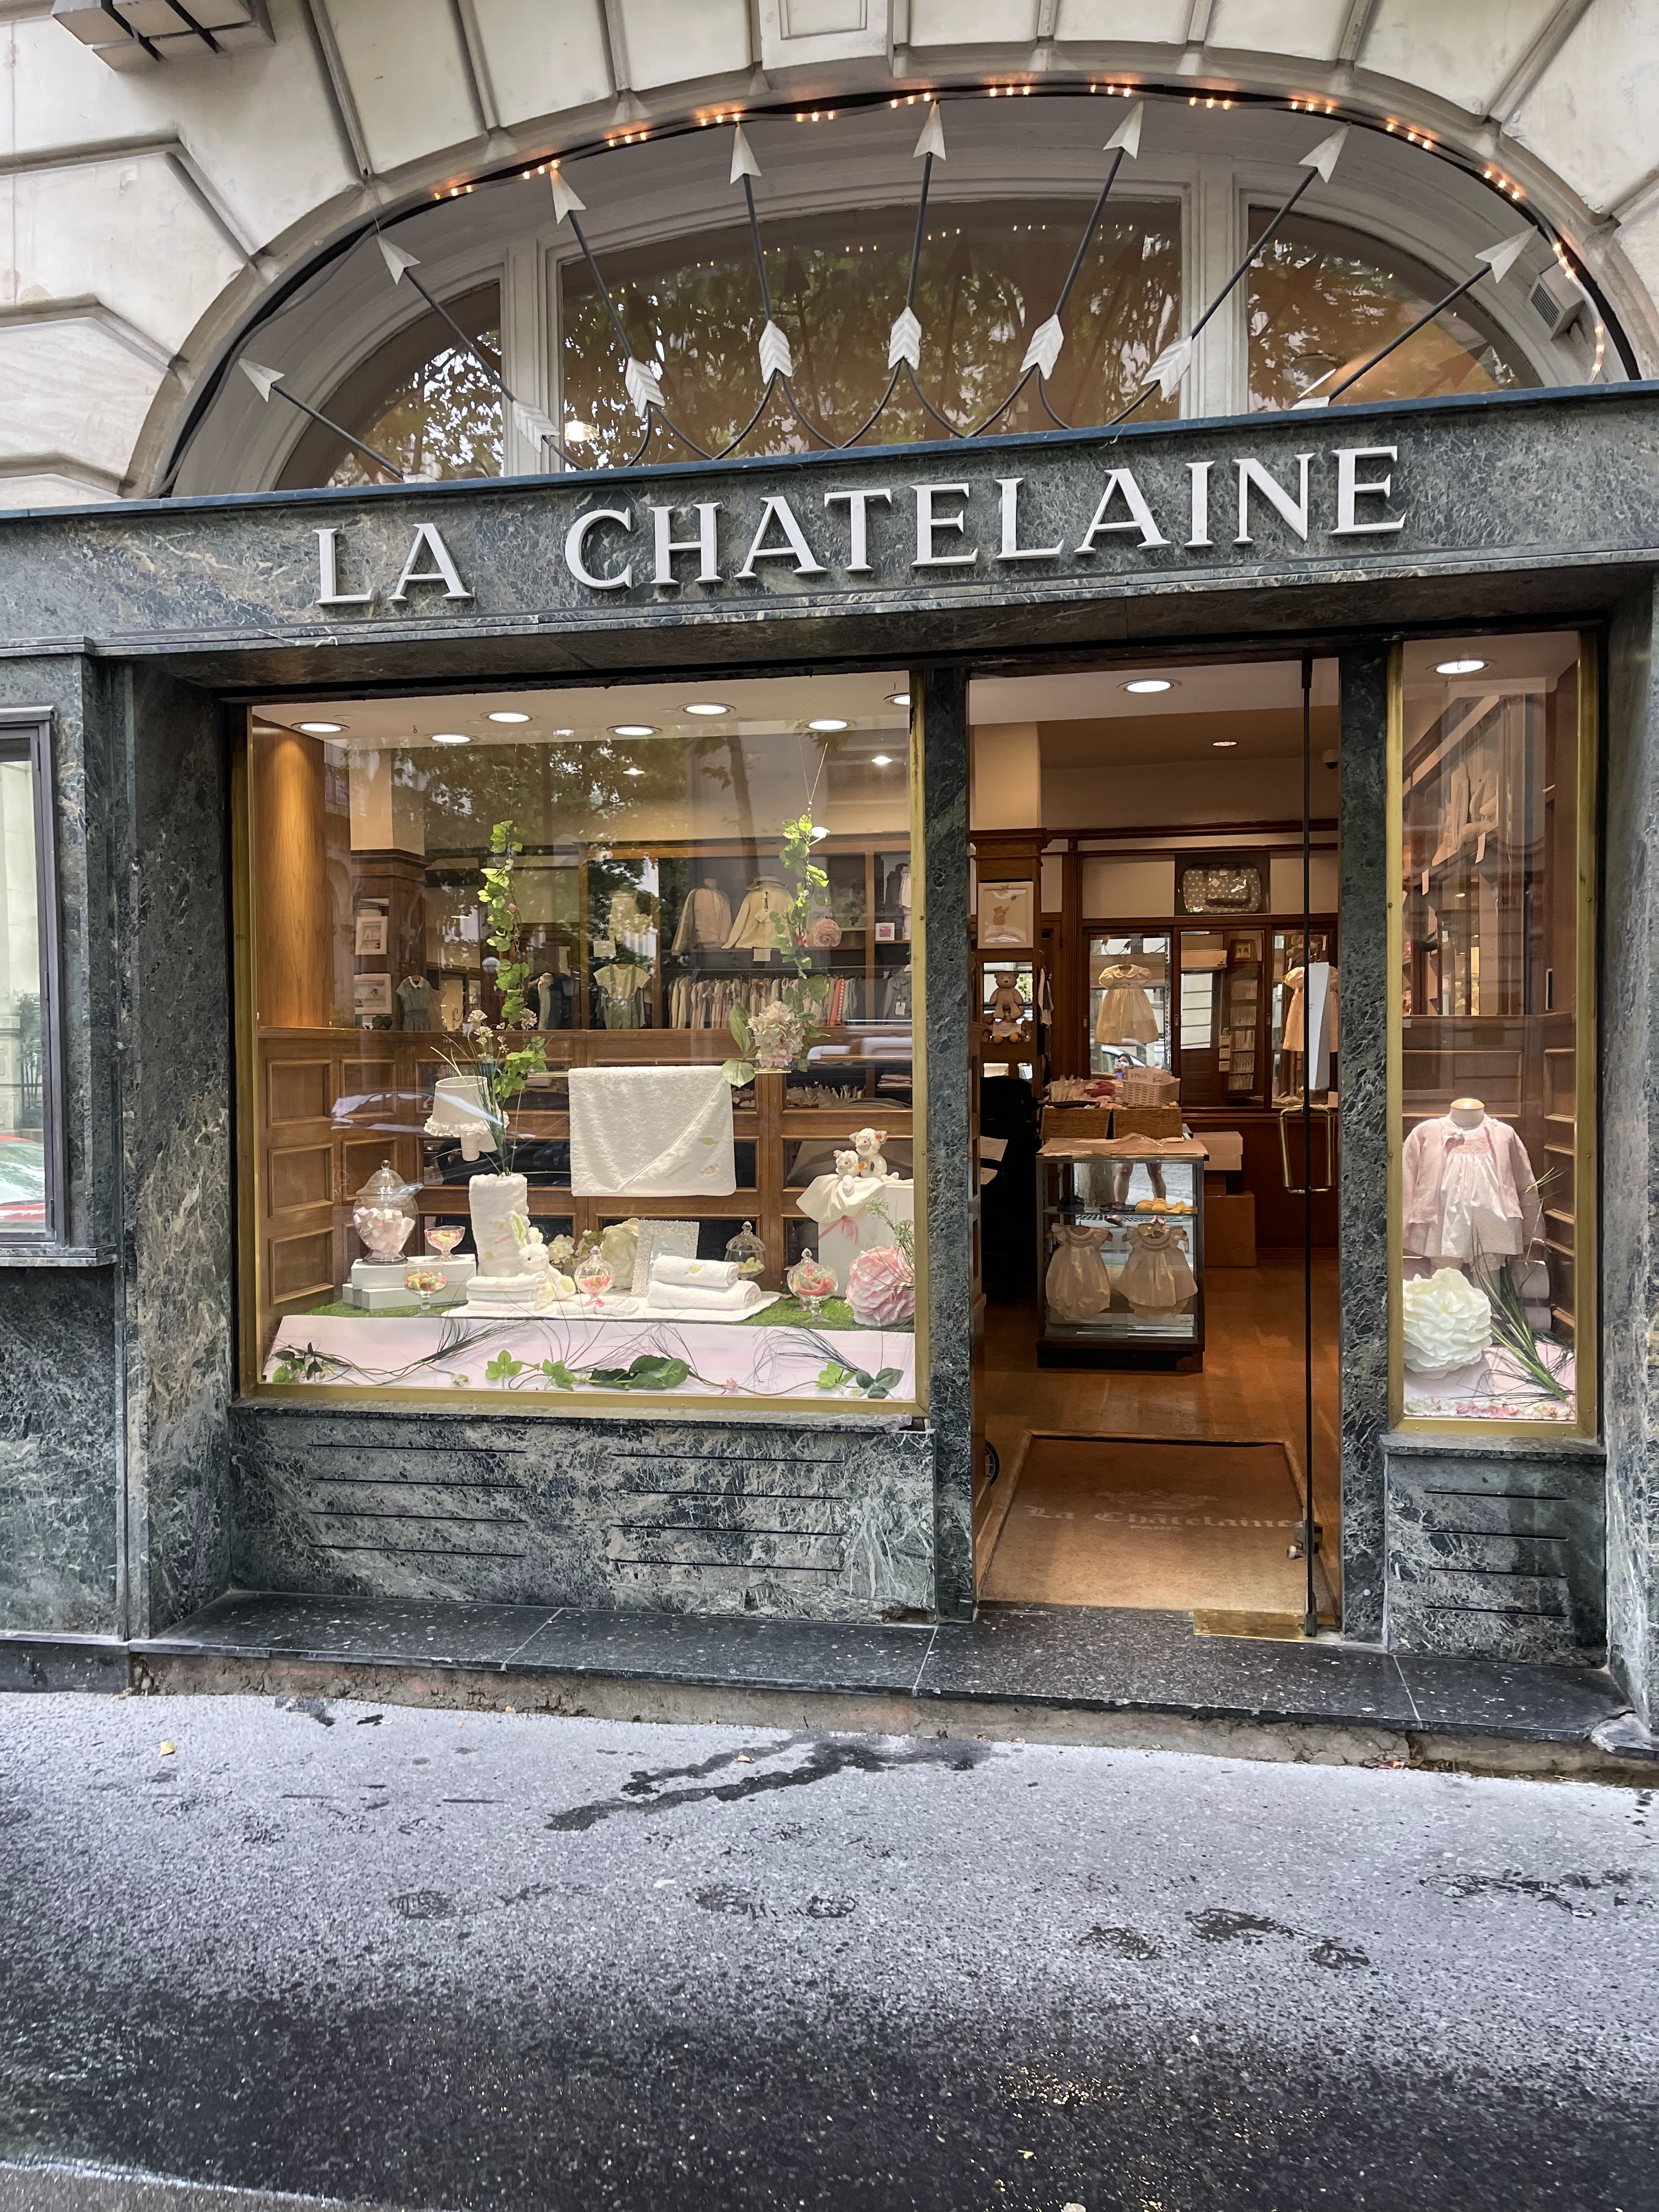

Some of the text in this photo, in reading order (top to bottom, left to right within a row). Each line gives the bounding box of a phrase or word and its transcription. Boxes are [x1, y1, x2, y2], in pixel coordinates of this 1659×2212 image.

[312, 445, 1407, 606] LA CHATELAINE
[1024, 1505, 1074, 1520] La
